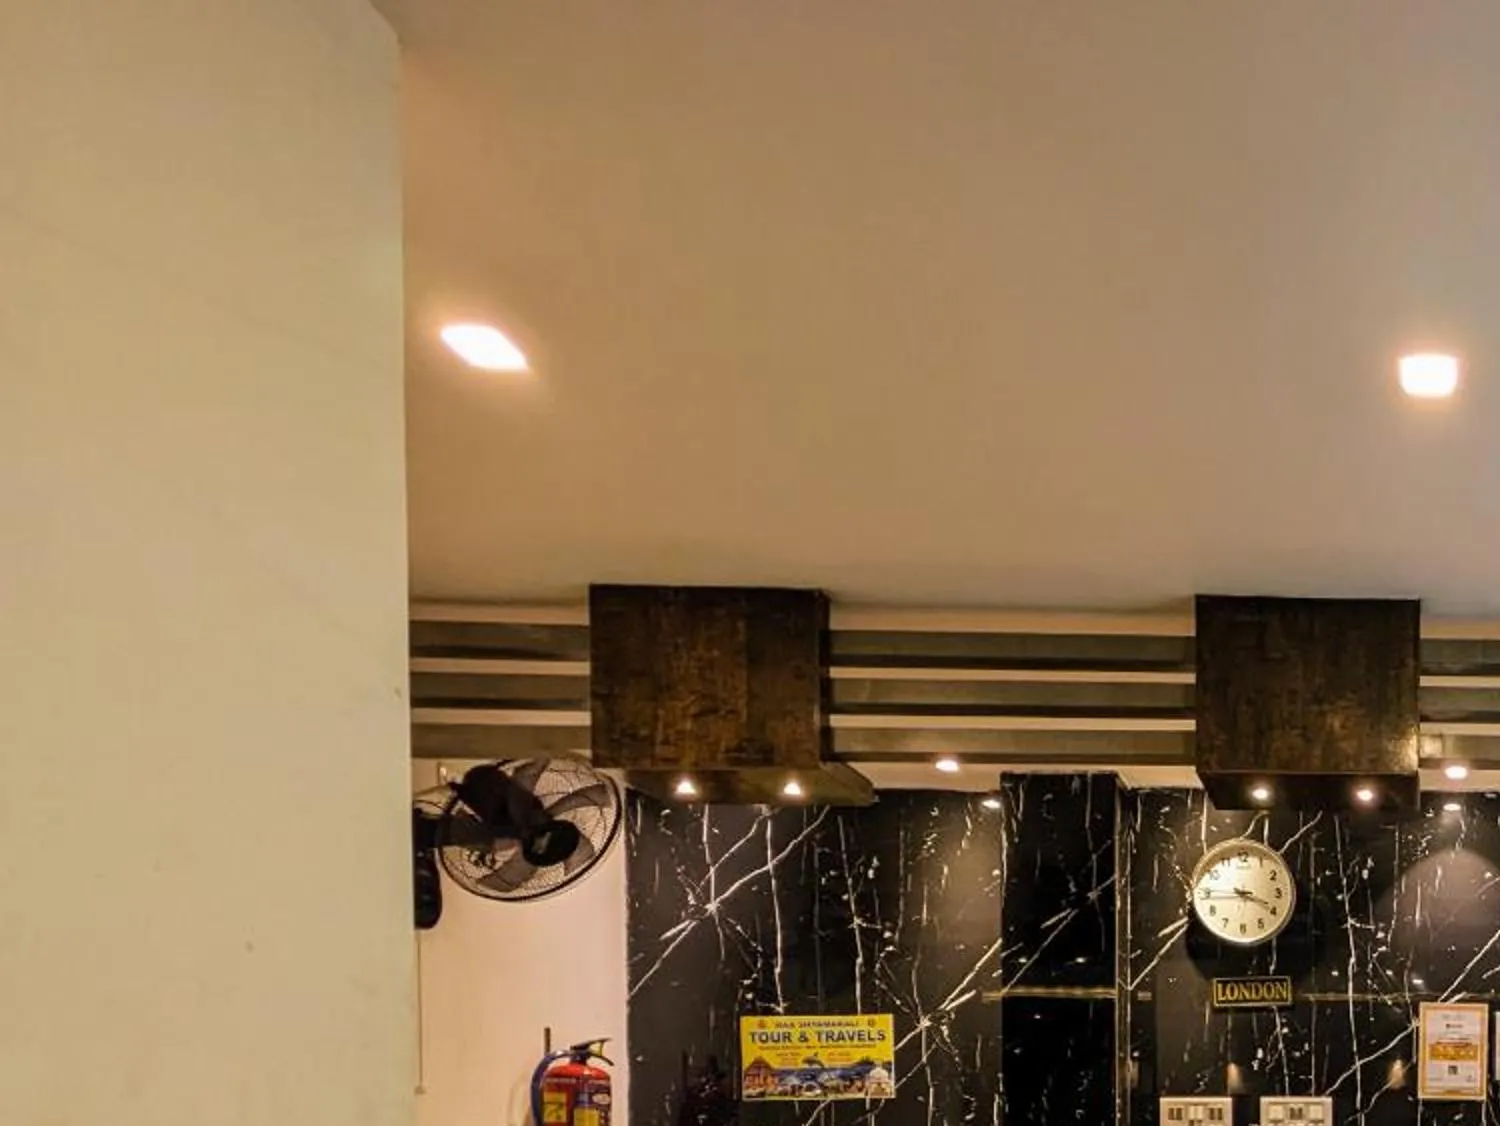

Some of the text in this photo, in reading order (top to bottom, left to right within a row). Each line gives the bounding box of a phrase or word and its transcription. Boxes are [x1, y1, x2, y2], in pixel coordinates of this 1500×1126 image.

[1221, 857, 1231, 868] 11
[1259, 857, 1263, 868] 1
[1269, 869, 1277, 881] 2
[1274, 887, 1282, 899] 3
[1269, 906, 1277, 916] 4
[1221, 918, 1229, 928] 7
[1257, 918, 1265, 929] 5
[1217, 982, 1287, 1000] LONDON
[749, 1030, 886, 1043] TOUR & TRAVELS
